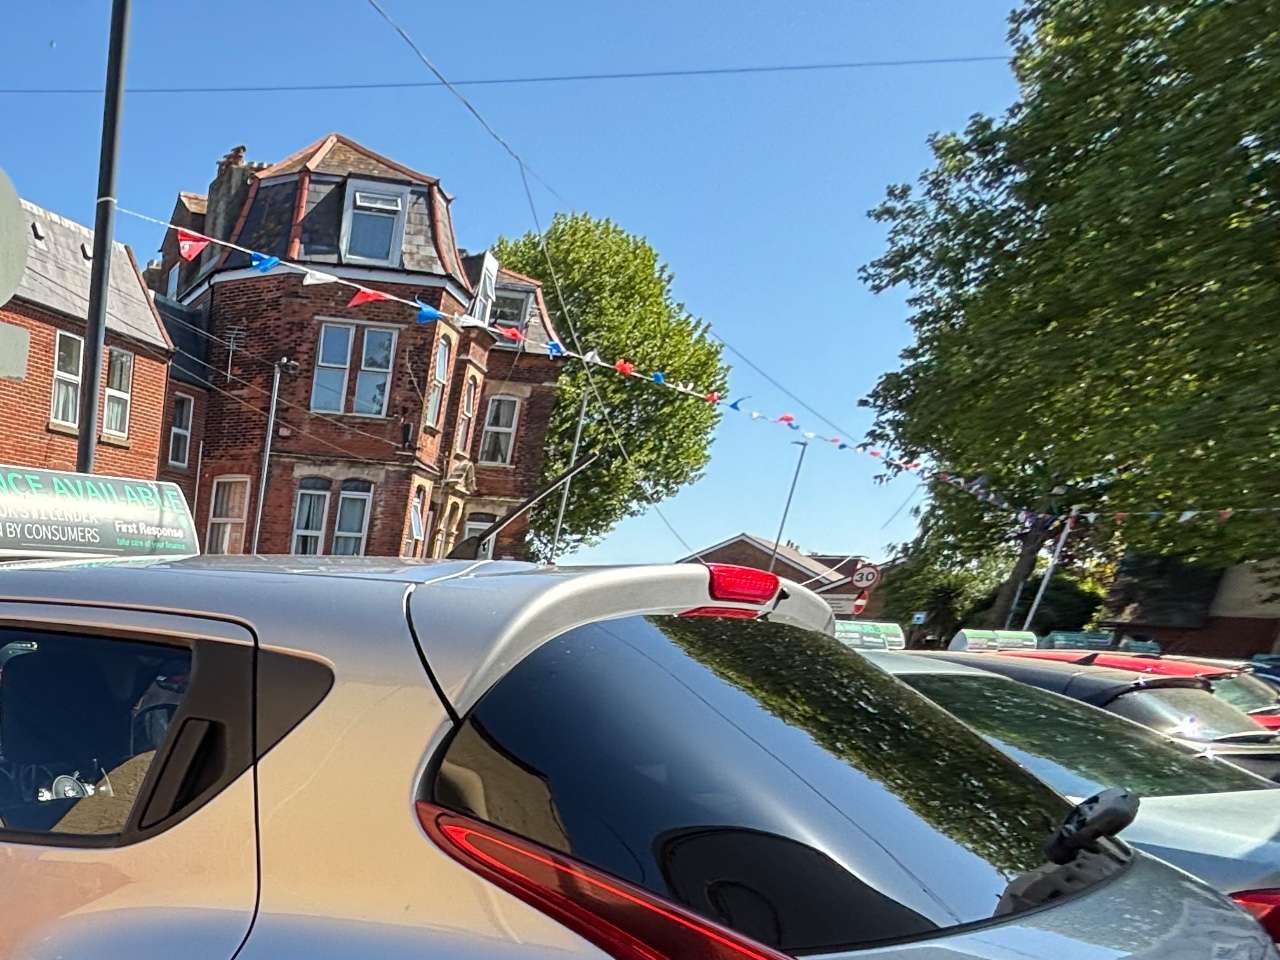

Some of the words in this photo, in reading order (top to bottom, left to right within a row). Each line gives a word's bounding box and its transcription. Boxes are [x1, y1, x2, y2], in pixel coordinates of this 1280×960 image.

[52, 477, 186, 515] AVAILABLE
[6, 522, 22, 539] BY
[24, 523, 100, 543] CONSUMERS
[115, 520, 138, 534] First
[139, 522, 184, 538] Response
[855, 572, 875, 582] 30
